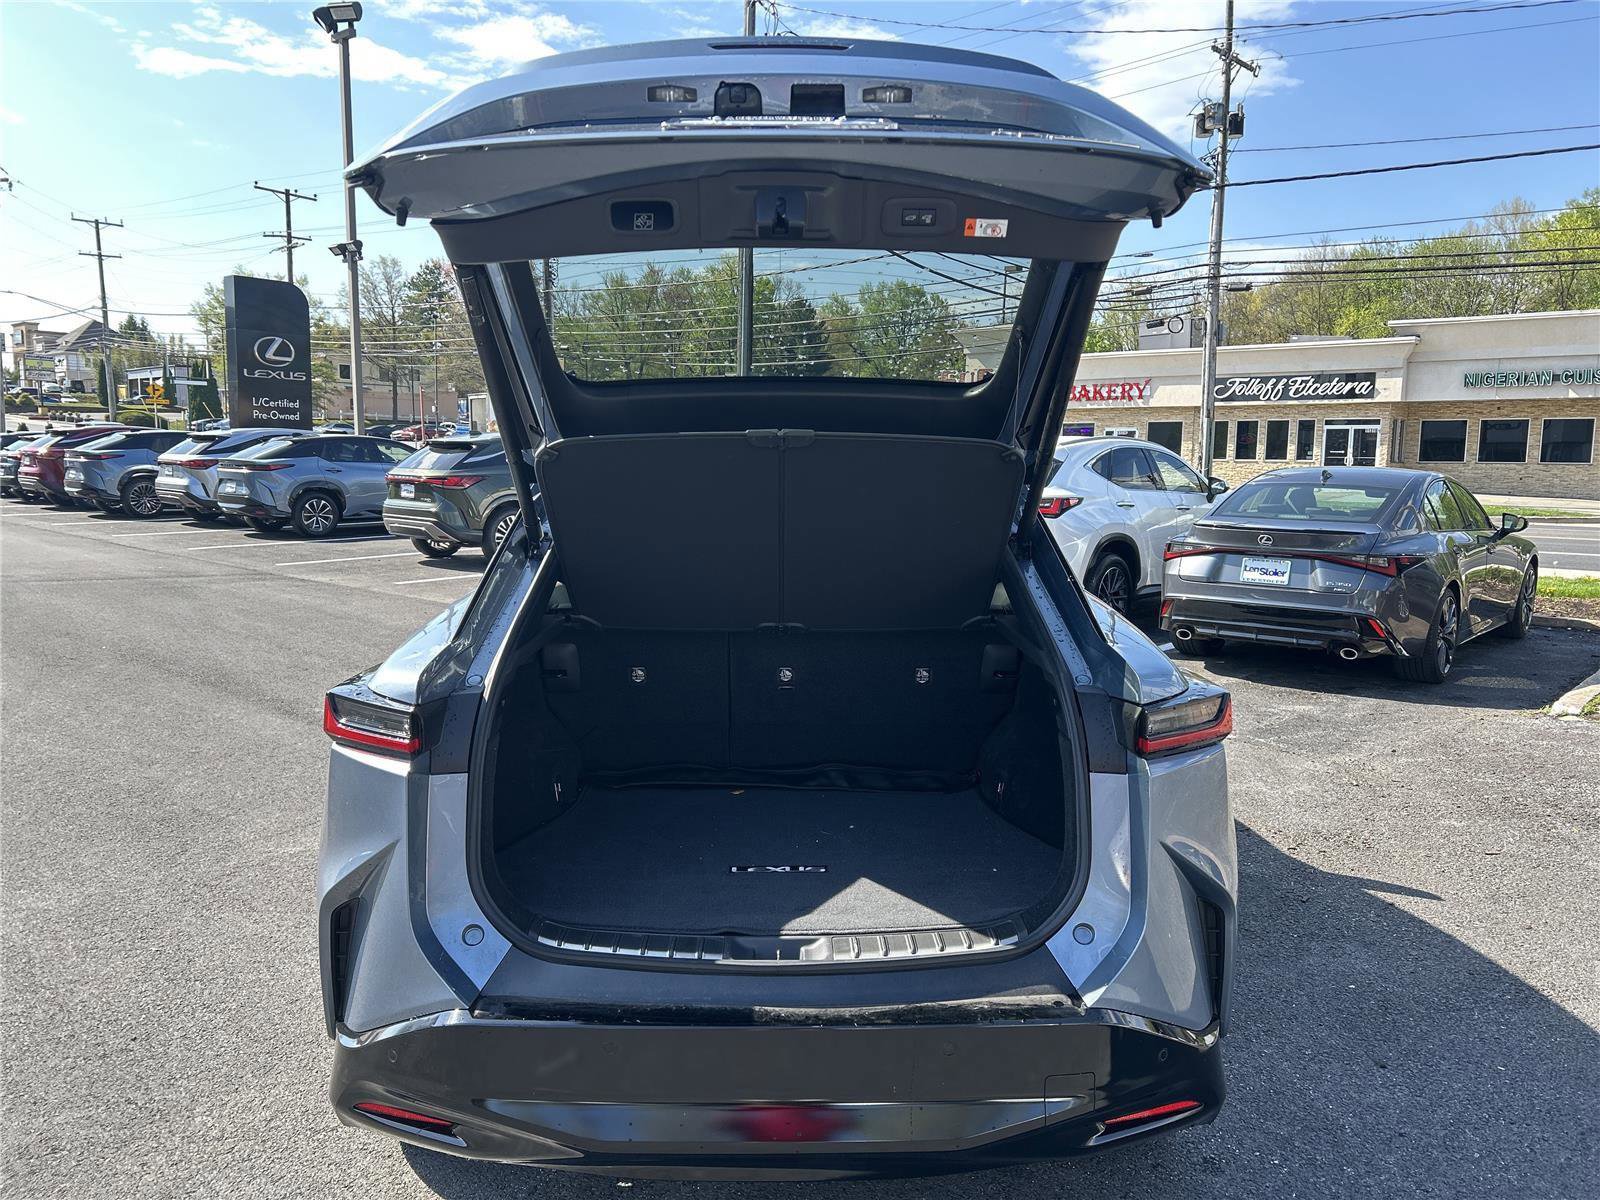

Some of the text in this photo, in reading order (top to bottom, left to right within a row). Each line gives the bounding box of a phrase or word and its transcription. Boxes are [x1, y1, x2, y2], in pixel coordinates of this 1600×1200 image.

[243, 368, 306, 380] LEXUS
[1463, 370, 1553, 388] NIGERIAN
[1288, 375, 1374, 398] Etcetera
[252, 397, 300, 408] L/Certified
[253, 409, 300, 421] Pre-Owned
